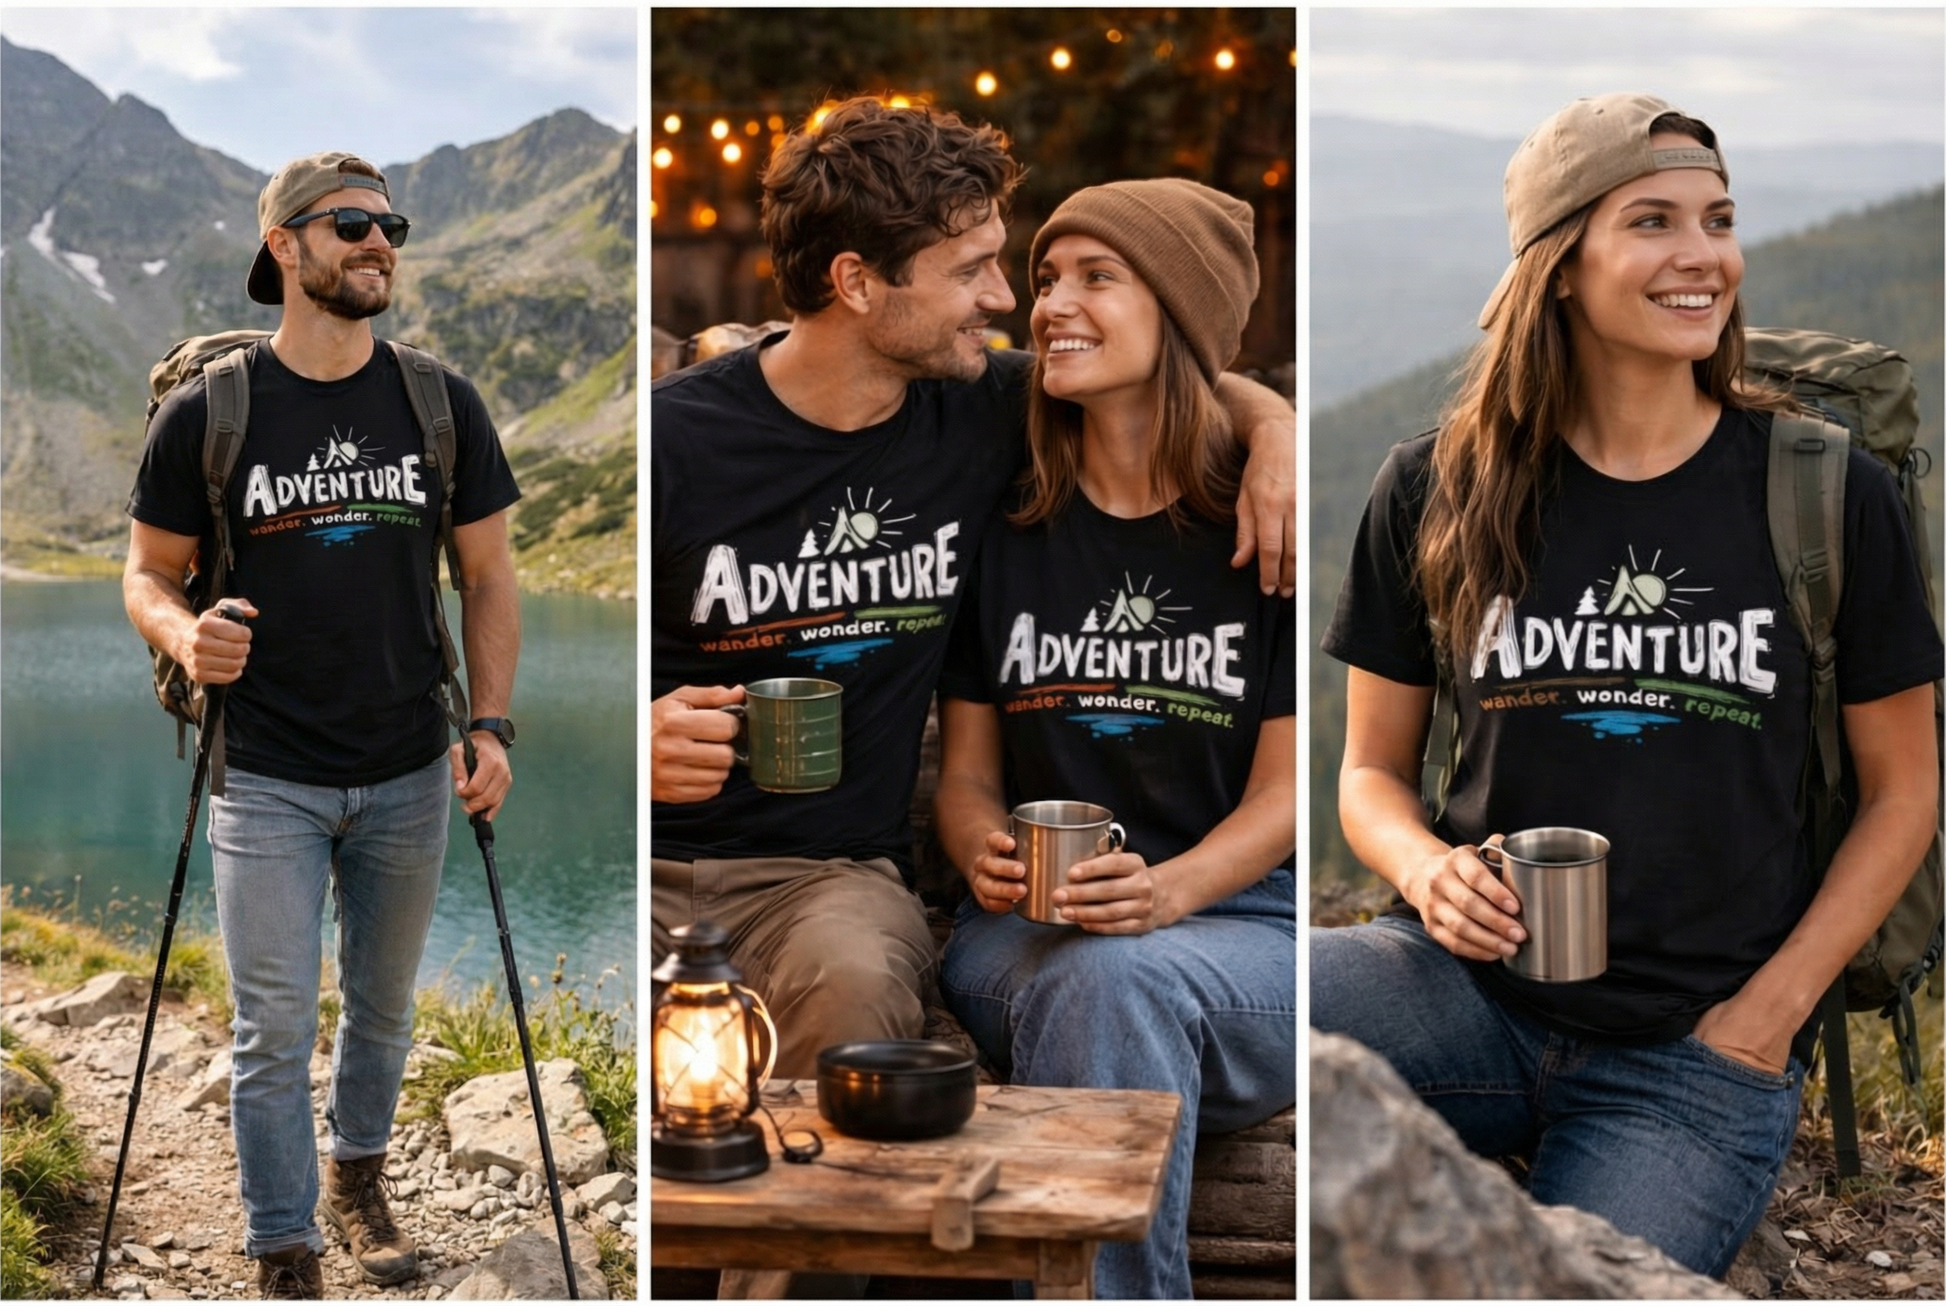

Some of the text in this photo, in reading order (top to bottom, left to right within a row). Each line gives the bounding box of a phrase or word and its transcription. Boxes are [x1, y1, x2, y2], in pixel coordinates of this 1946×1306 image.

[243, 454, 427, 518] ADVENTURE
[311, 509, 373, 526] wonder.
[690, 520, 960, 625] ADVENTURE
[800, 617, 891, 642] wonder.
[1470, 594, 1779, 699] ADVENTURE
[998, 612, 1247, 701] ADVENTURE
[1077, 694, 1161, 713] wonder.
[1167, 702, 1234, 729] repeat.
[1577, 688, 1676, 710] wonder.
[1684, 698, 1763, 731] repeat.
